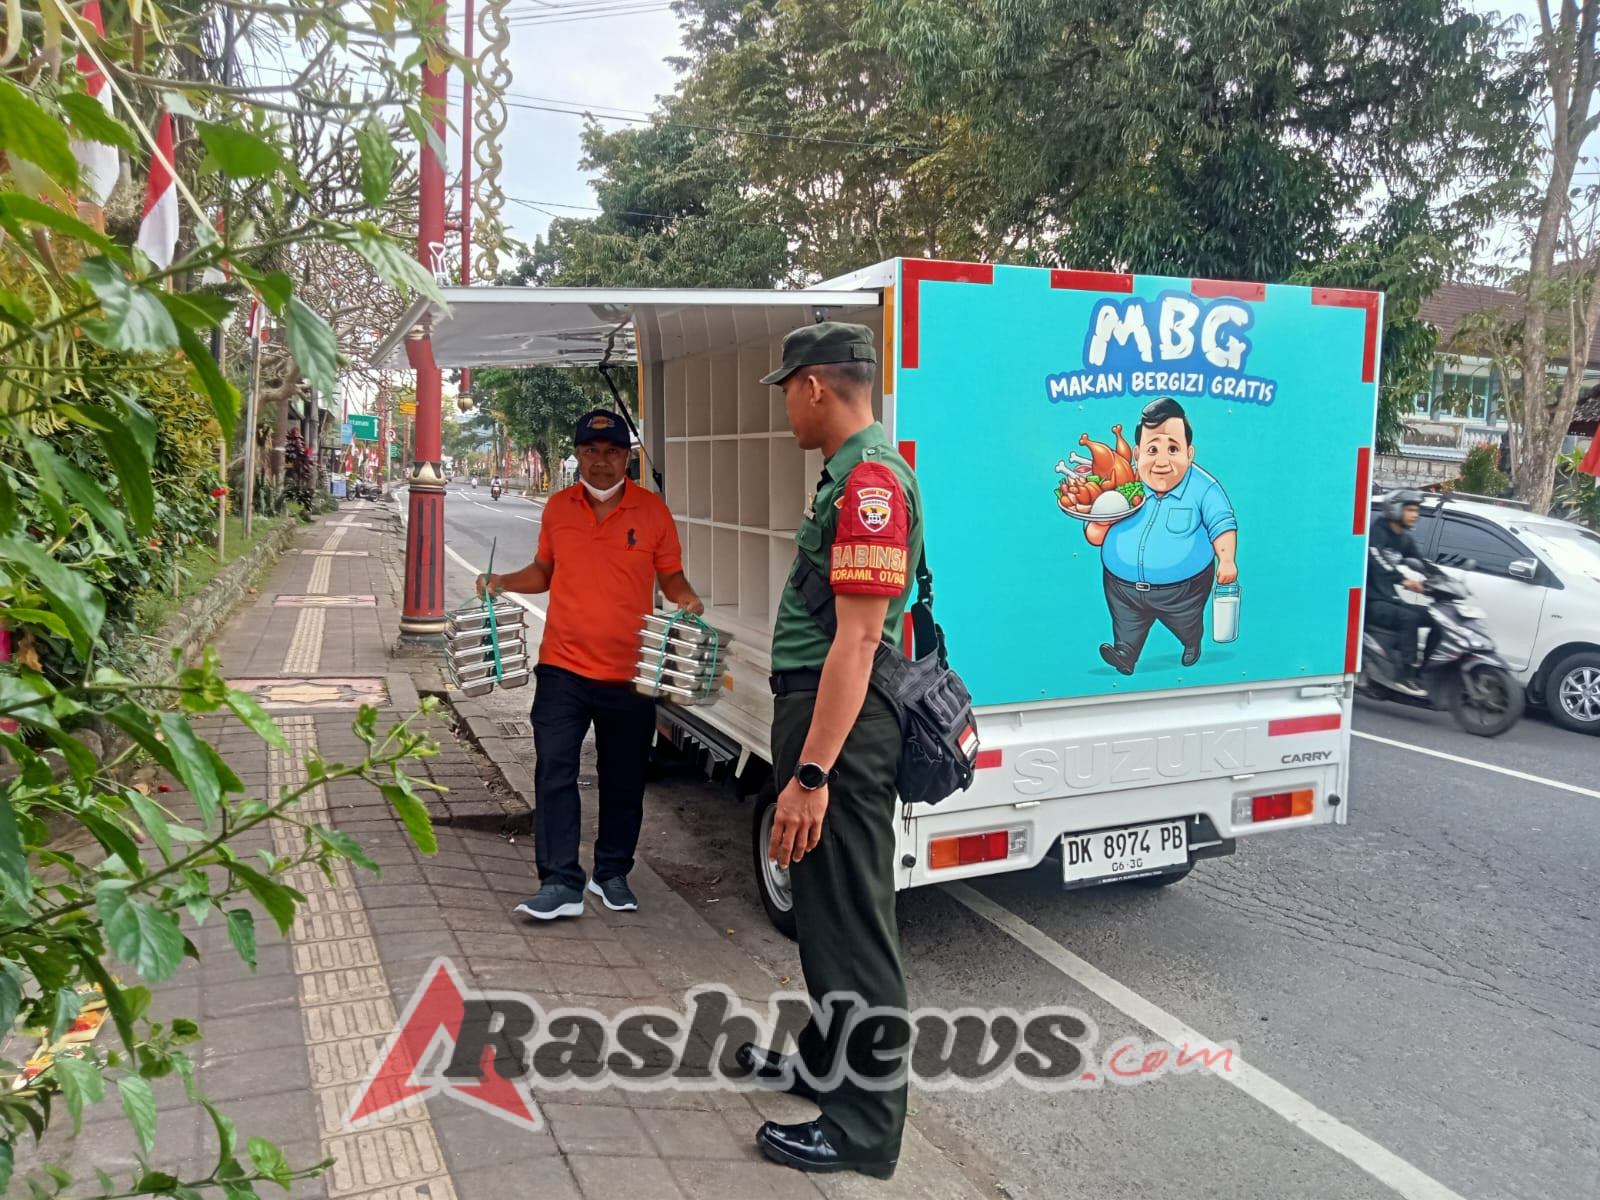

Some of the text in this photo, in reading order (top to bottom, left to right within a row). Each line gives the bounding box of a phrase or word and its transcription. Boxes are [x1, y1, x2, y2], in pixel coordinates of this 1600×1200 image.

[1089, 297, 1249, 370] MBG
[1050, 372, 1274, 402] MAKAN BERGIZI GRATIS
[832, 545, 907, 572] BABINSA
[1013, 726, 1259, 795] SUZUKI
[1281, 751, 1333, 764] CARRY
[1069, 826, 1183, 865] DK 8974 PB
